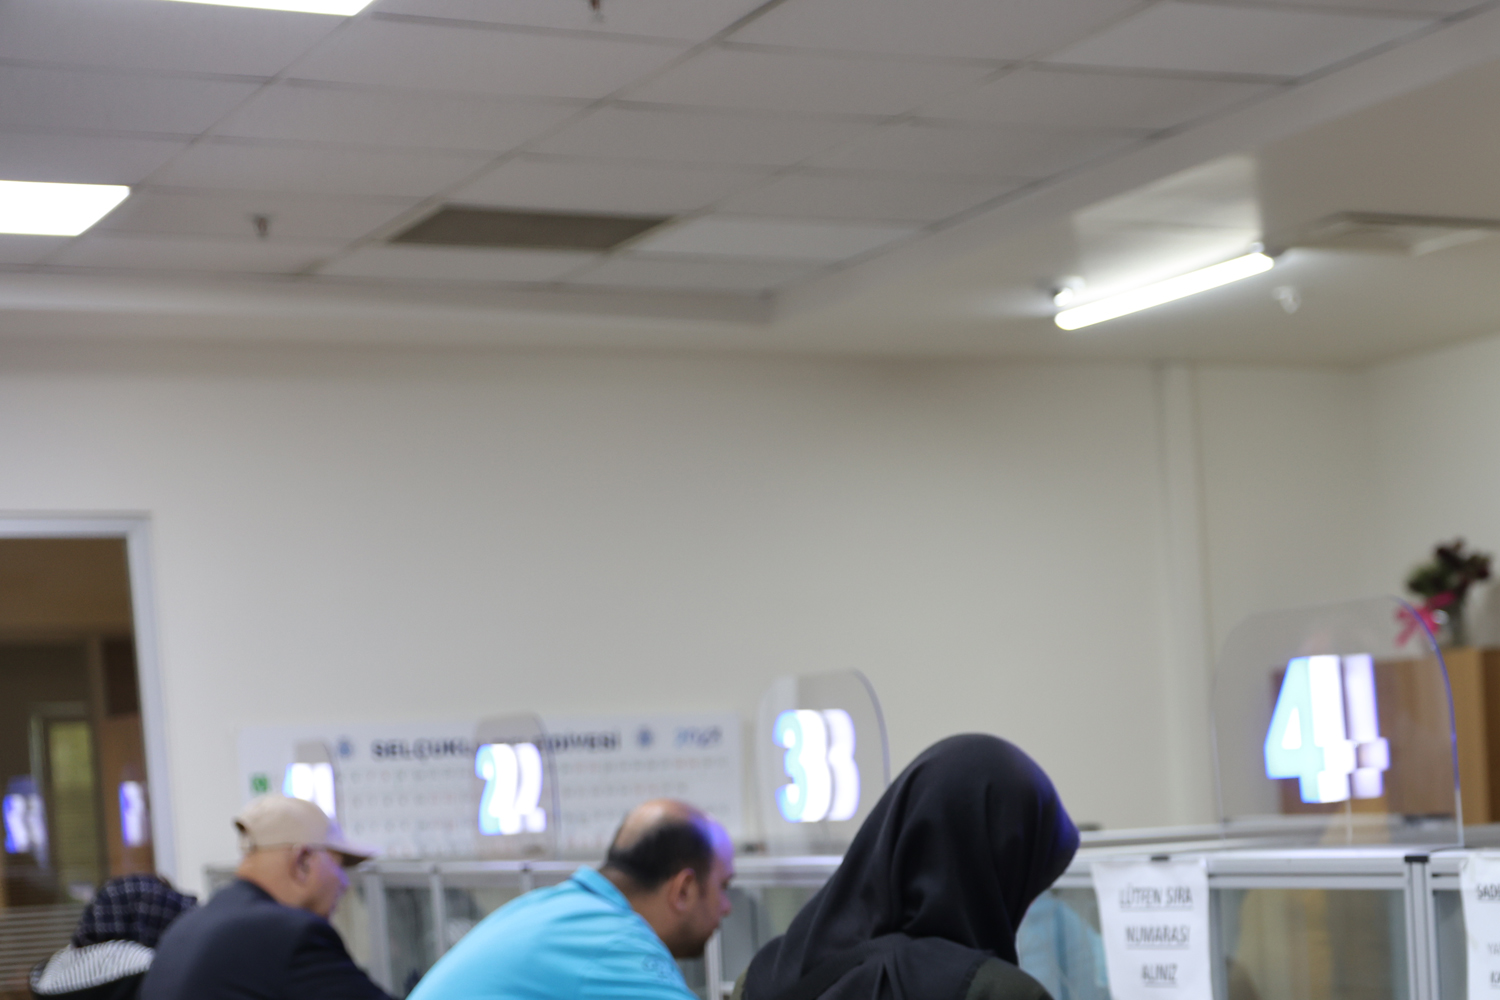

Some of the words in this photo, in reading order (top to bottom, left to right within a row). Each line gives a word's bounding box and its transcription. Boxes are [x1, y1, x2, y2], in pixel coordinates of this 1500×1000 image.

[1264, 655, 1358, 803] 4
[475, 743, 526, 835] 2
[774, 708, 836, 822] 3
[1119, 882, 1162, 905] LÜTFEN
[1166, 885, 1193, 904] SIRA
[1125, 924, 1190, 943] NUMARASI
[1142, 963, 1178, 981] ALINIZ
